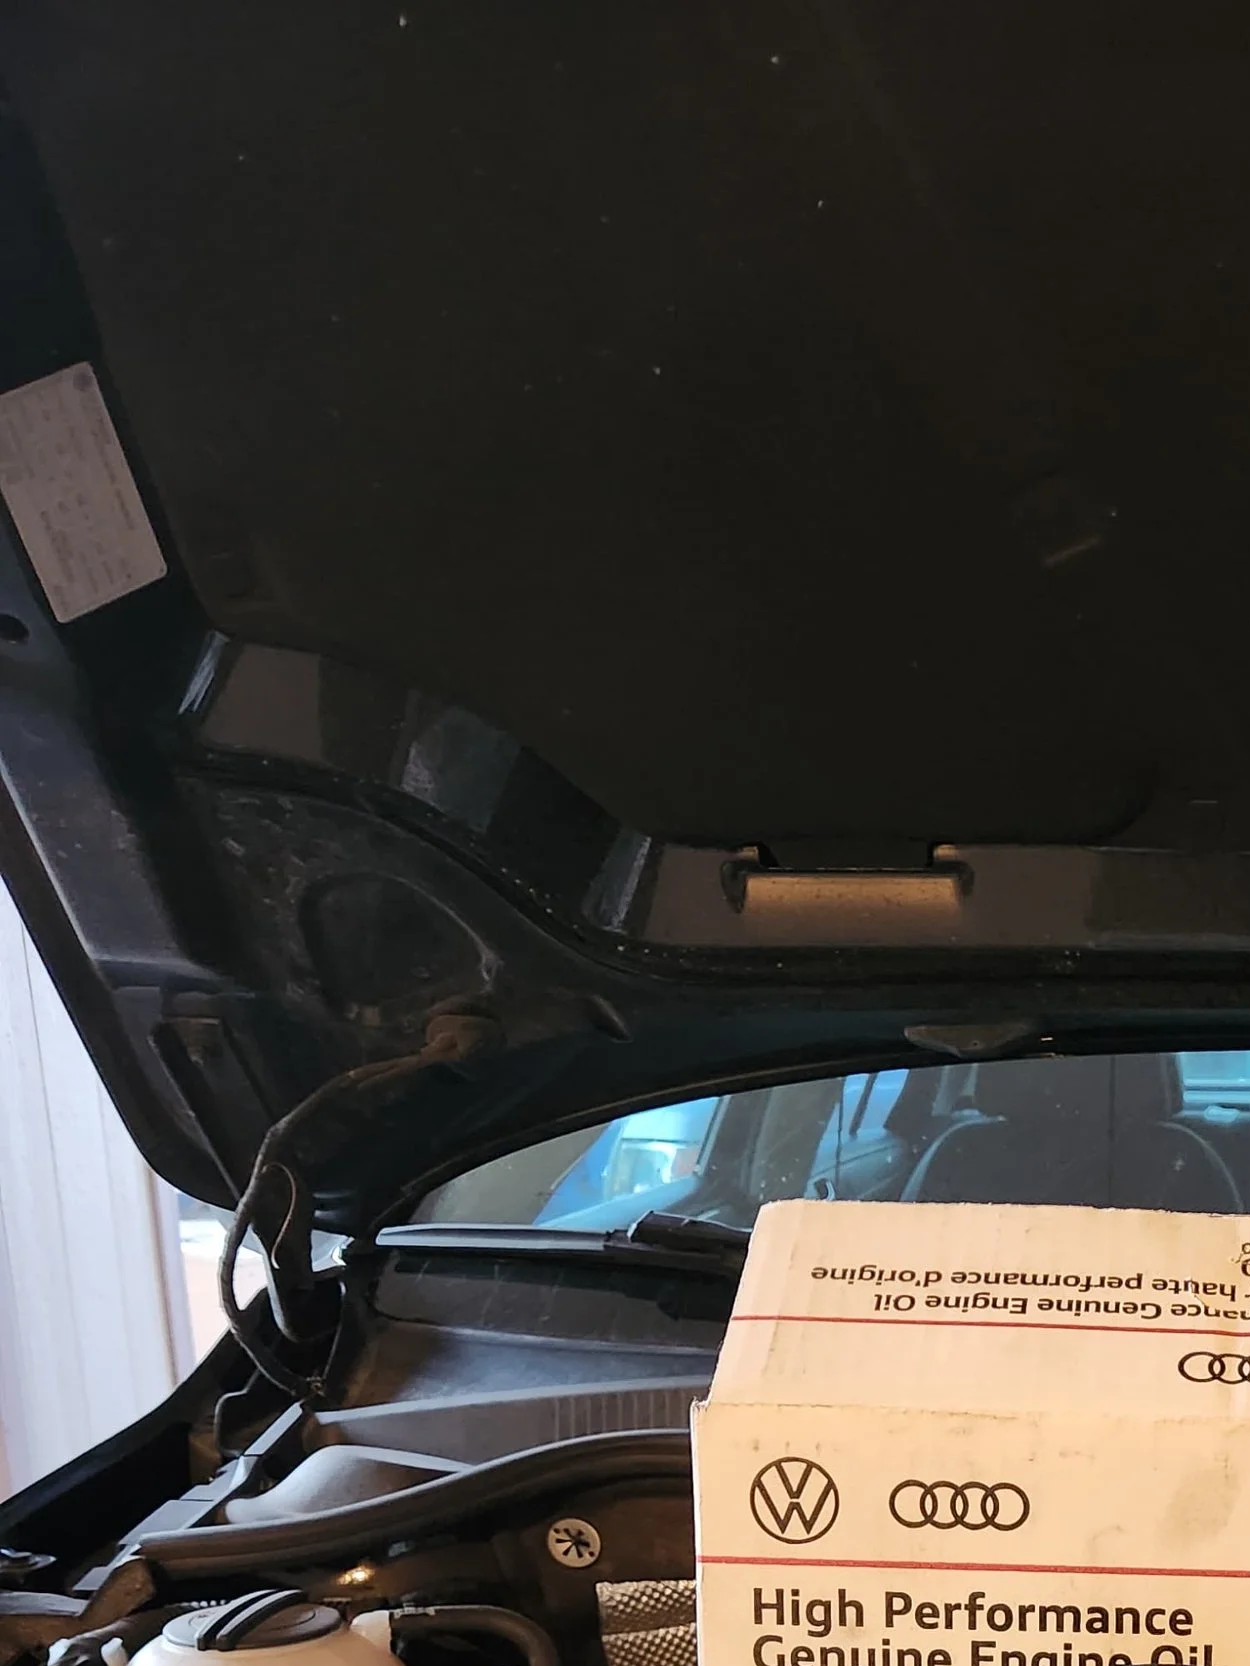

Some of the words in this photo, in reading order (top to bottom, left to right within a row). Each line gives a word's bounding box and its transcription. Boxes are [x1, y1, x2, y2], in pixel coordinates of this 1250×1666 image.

[810, 1264, 943, 1288] d'origine
[950, 1271, 1143, 1293] performance
[1151, 1277, 1237, 1302] haute
[873, 1293, 916, 1312] Oil
[924, 1291, 1029, 1315] Engine
[1037, 1297, 1162, 1320] Genuine
[752, 1587, 865, 1638] High
[884, 1590, 1194, 1637] Performance
